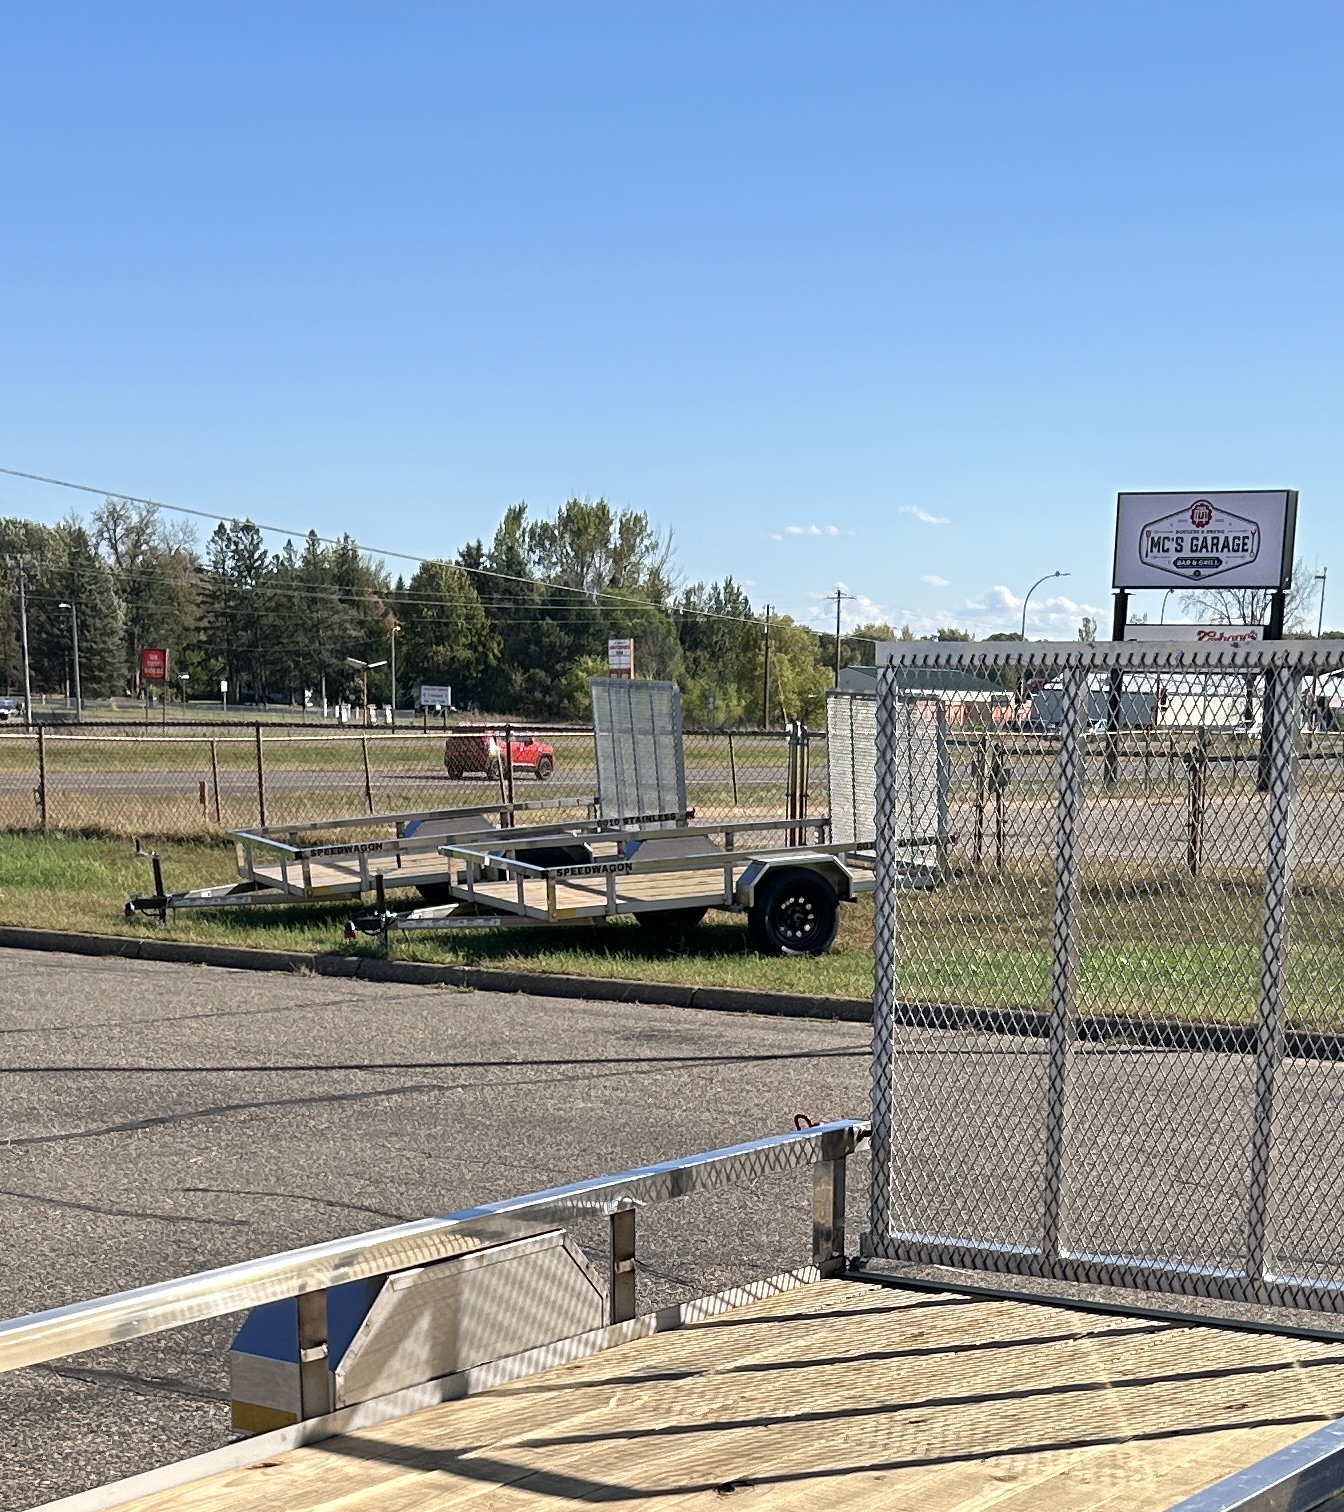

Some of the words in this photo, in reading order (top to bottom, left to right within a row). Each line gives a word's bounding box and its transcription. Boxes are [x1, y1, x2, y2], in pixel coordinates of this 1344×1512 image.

[1150, 536, 1184, 553] MC'S
[1190, 535, 1250, 553] GARAGE
[623, 813, 677, 825] STAINLESS
[310, 843, 383, 857] SPEEDWAGON
[556, 863, 633, 877] SPEEDWAGON
